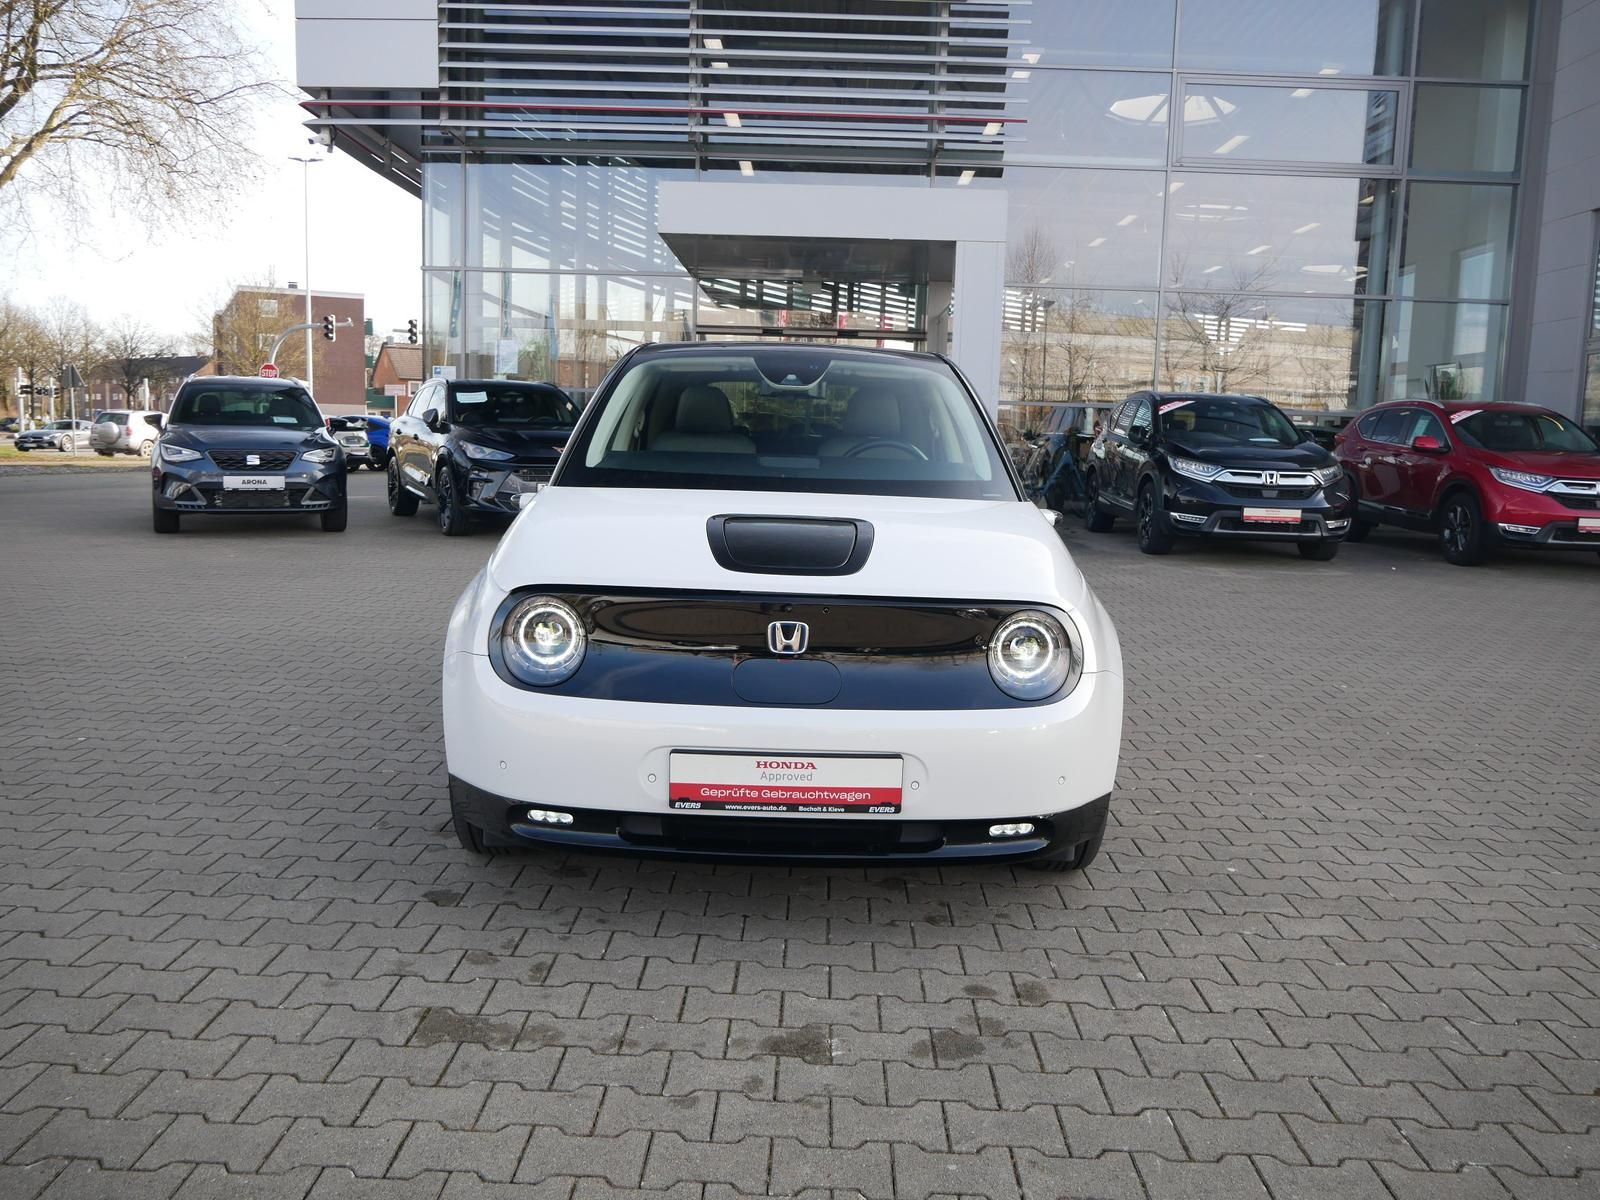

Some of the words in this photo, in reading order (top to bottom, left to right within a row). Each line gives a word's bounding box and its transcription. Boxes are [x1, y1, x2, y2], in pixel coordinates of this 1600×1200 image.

[261, 369, 277, 377] STOP
[755, 760, 817, 770] HONDA
[760, 771, 813, 782] Approved
[700, 787, 759, 798] Geprüfte
[761, 789, 871, 802] Gebrauchtwagen
[674, 801, 702, 809] EVERS
[725, 803, 787, 811] www.evers-auto.de
